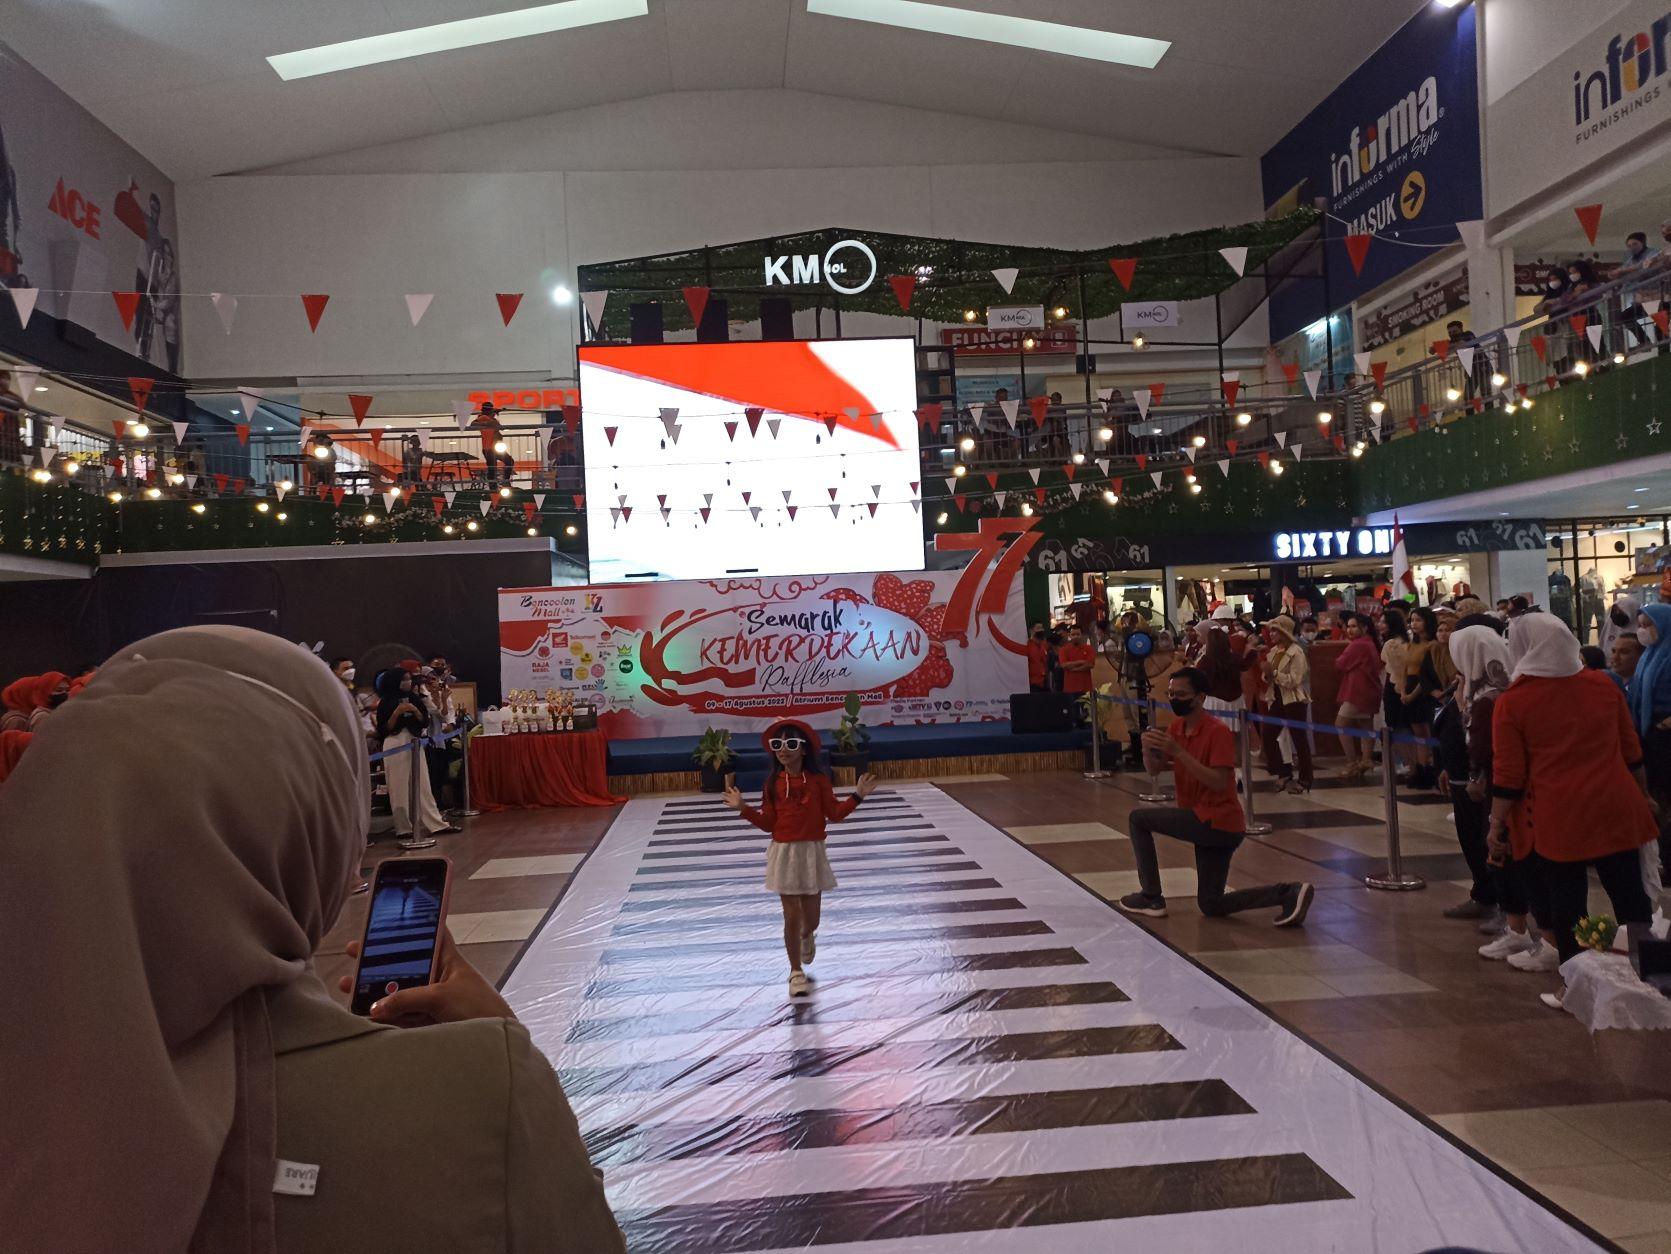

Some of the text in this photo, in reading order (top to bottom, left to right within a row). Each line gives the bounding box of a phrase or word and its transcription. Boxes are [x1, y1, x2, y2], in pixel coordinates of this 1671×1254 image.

[1576, 86, 1660, 144] FURNISHINGS
[1331, 76, 1438, 197] informa
[1333, 128, 1439, 211] FURNISHINGS WITH Style
[48, 176, 101, 240] ACE
[1347, 193, 1397, 236] MASUK
[1388, 290, 1445, 328] SMOKING ROOM
[1128, 544, 1150, 564] 61
[1276, 530, 1350, 559] SIXTY
[1456, 527, 1480, 547] 61
[934, 516, 1044, 632] 77
[1038, 549, 1068, 571] 61
[747, 600, 844, 635] Semarak
[700, 628, 921, 667] KEMERDEKAAN
[760, 656, 852, 693] Rafflesia
[706, 700, 716, 709] 09
[724, 700, 733, 708] 17
[733, 699, 766, 710] Agustus
[767, 697, 785, 706] 2022
[794, 696, 824, 704] Atrium
[867, 692, 884, 701] Mall
